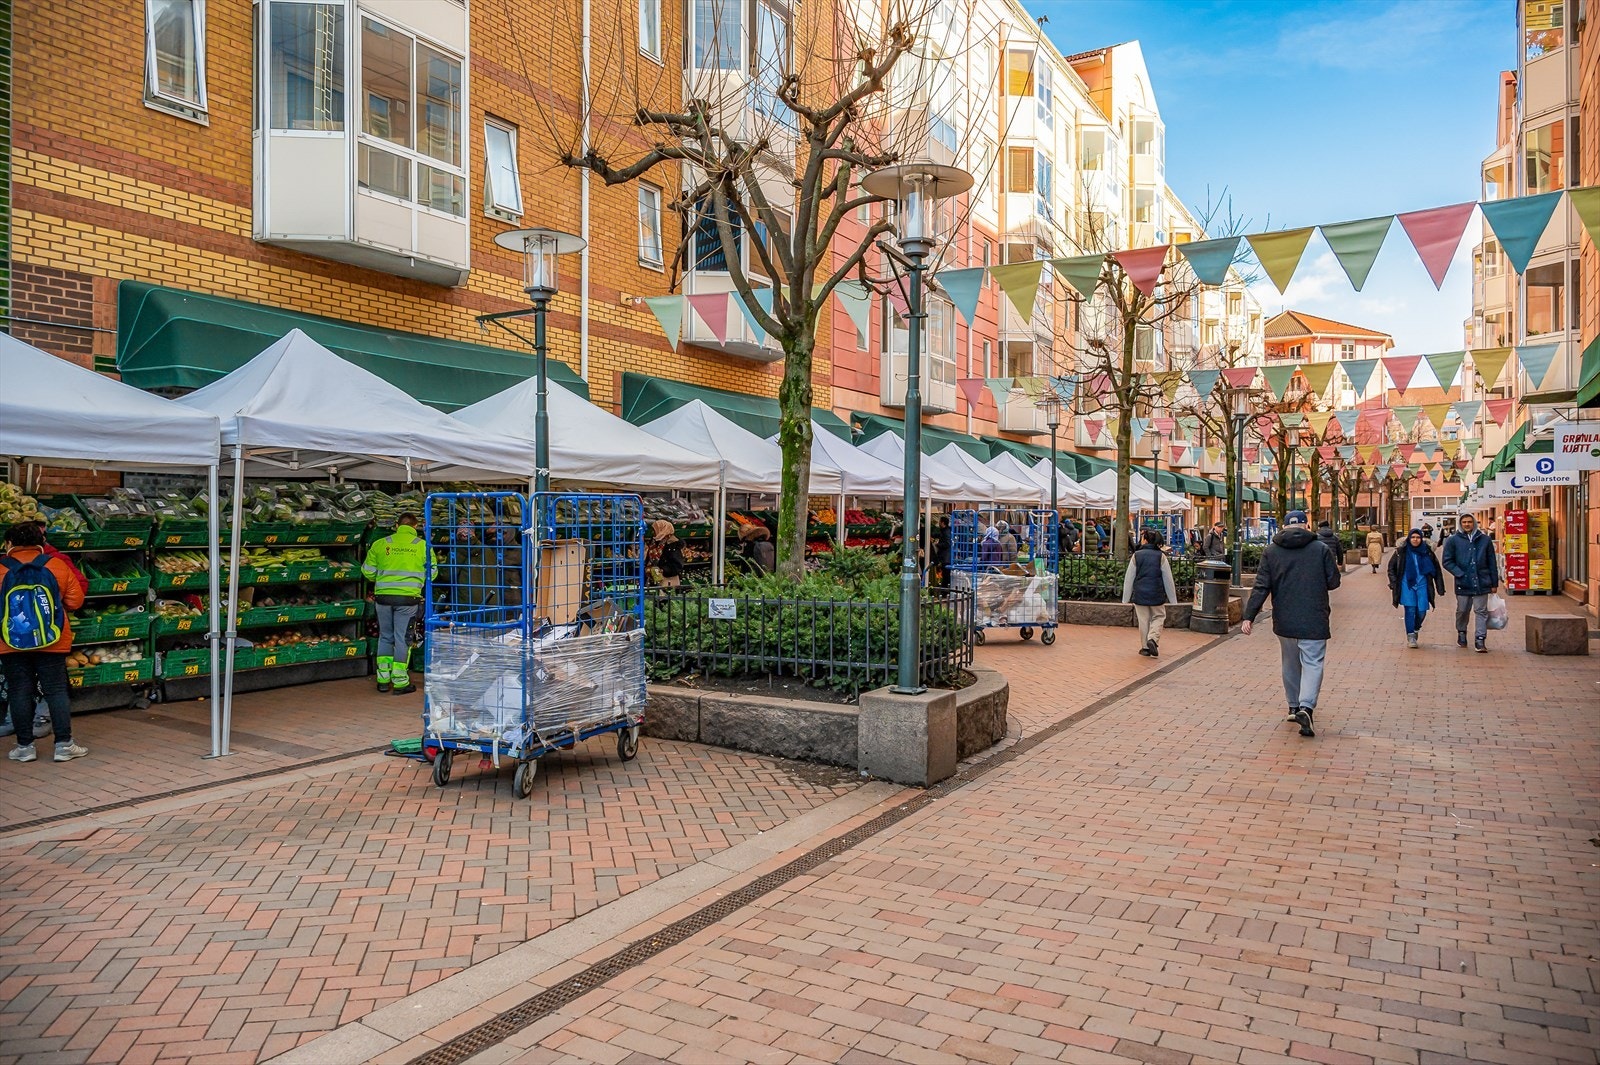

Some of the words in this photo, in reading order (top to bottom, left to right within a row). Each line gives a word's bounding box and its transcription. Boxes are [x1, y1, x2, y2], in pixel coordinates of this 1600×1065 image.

[1562, 433, 1600, 444] GRØNLA
[1562, 444, 1591, 454] KJØTT
[1524, 475, 1570, 483] Dollarstore
